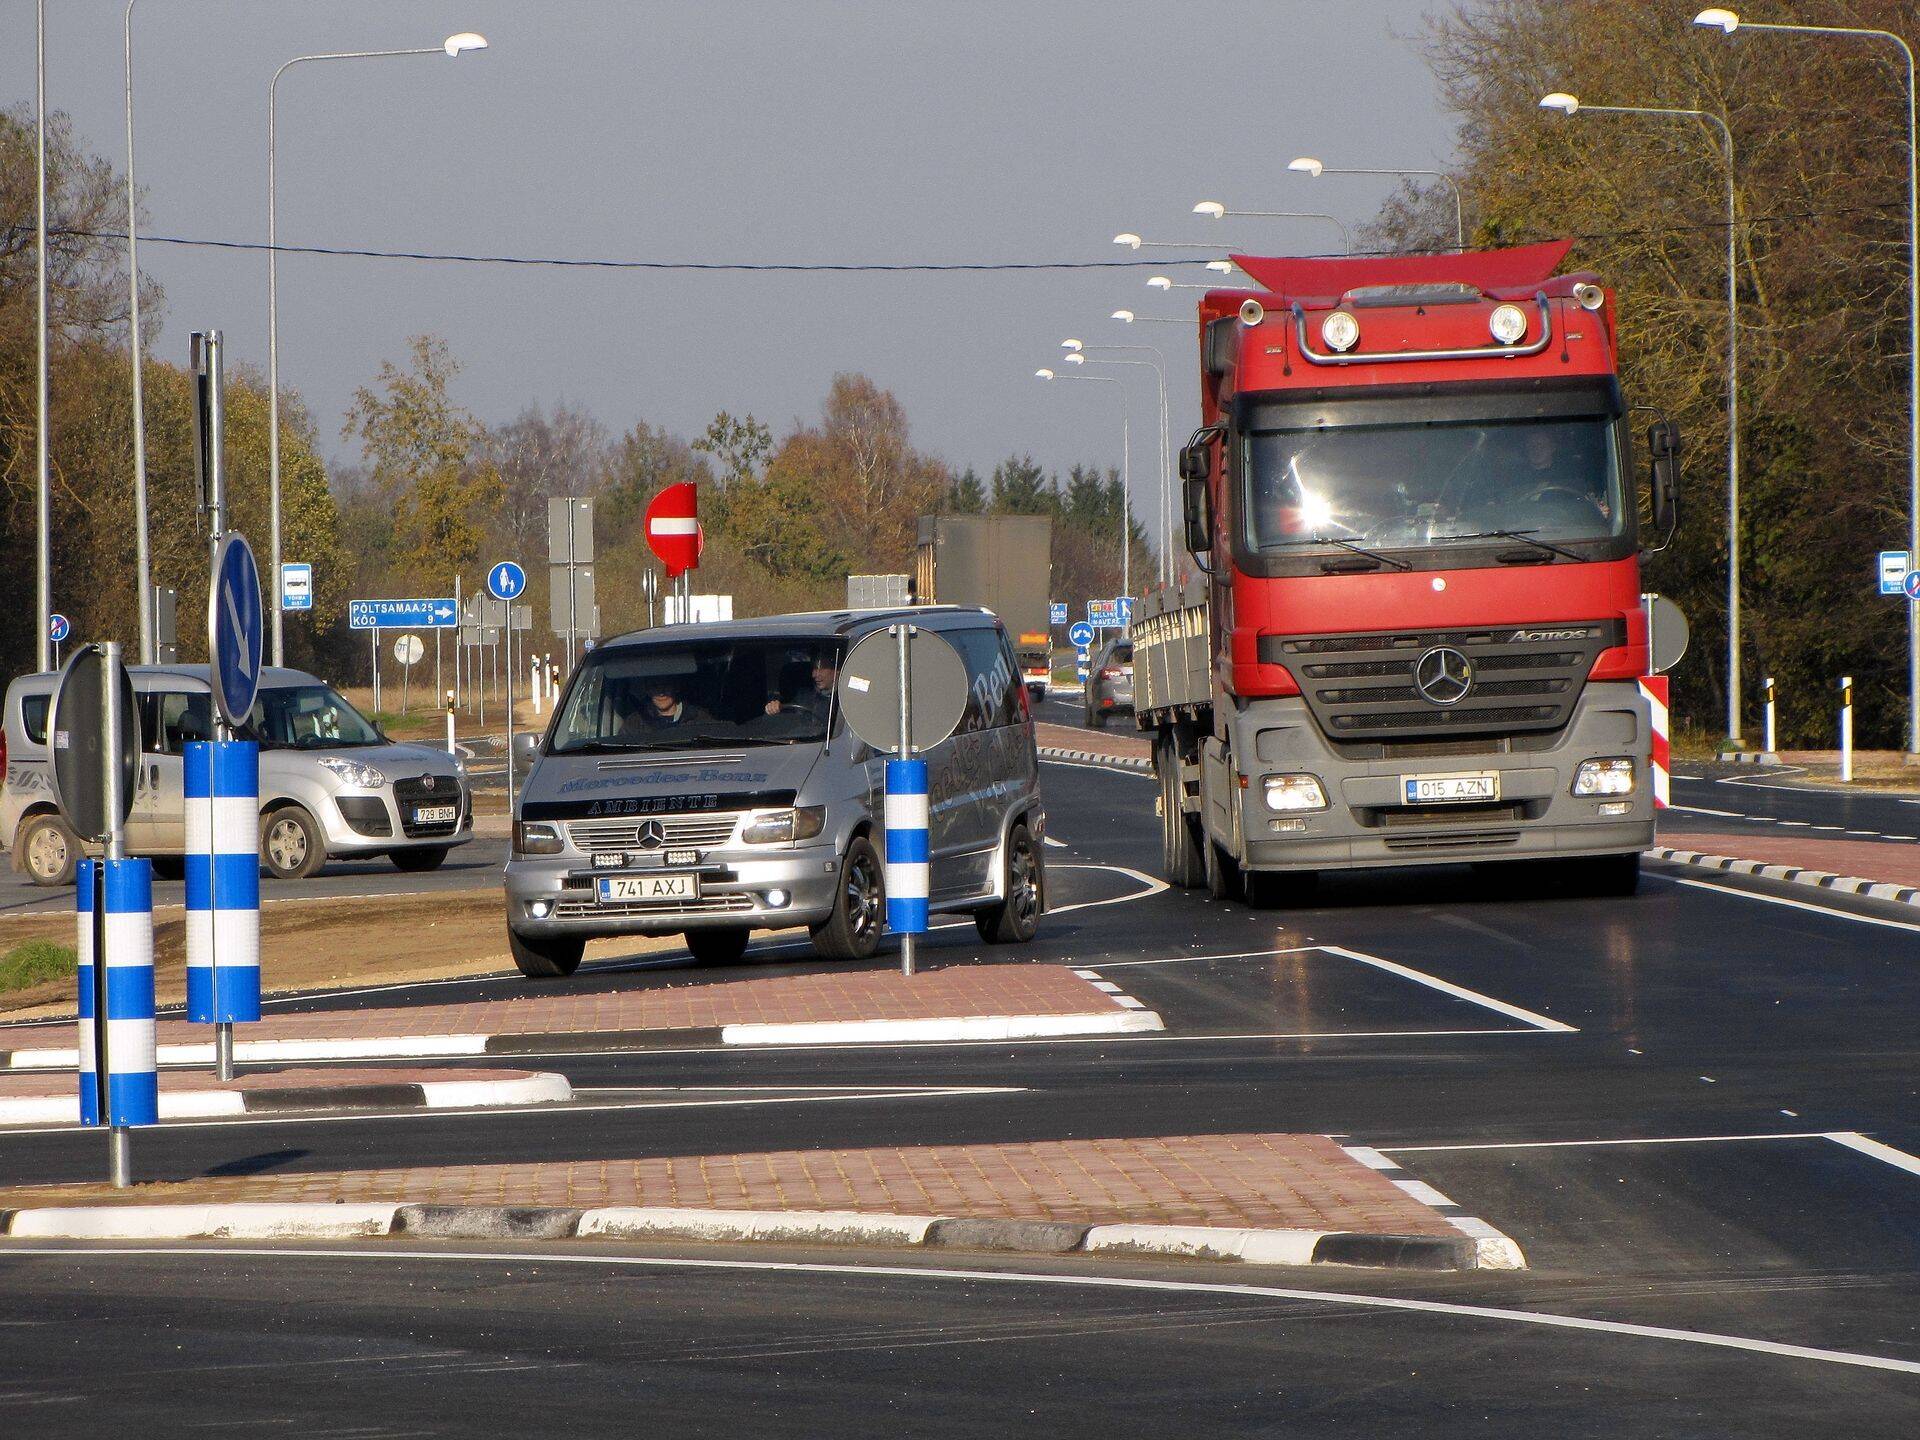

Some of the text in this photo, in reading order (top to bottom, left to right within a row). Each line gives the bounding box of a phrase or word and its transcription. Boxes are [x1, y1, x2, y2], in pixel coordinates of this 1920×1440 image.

[353, 603, 434, 614] PÕLTSAMAA 25
[353, 615, 434, 625] KÕO 9
[1421, 780, 1488, 796] 015 AZN
[587, 794, 719, 815] AMBIENTE
[420, 809, 434, 820] 729
[438, 808, 454, 819] BNH
[617, 879, 685, 897] 741 AXJ
